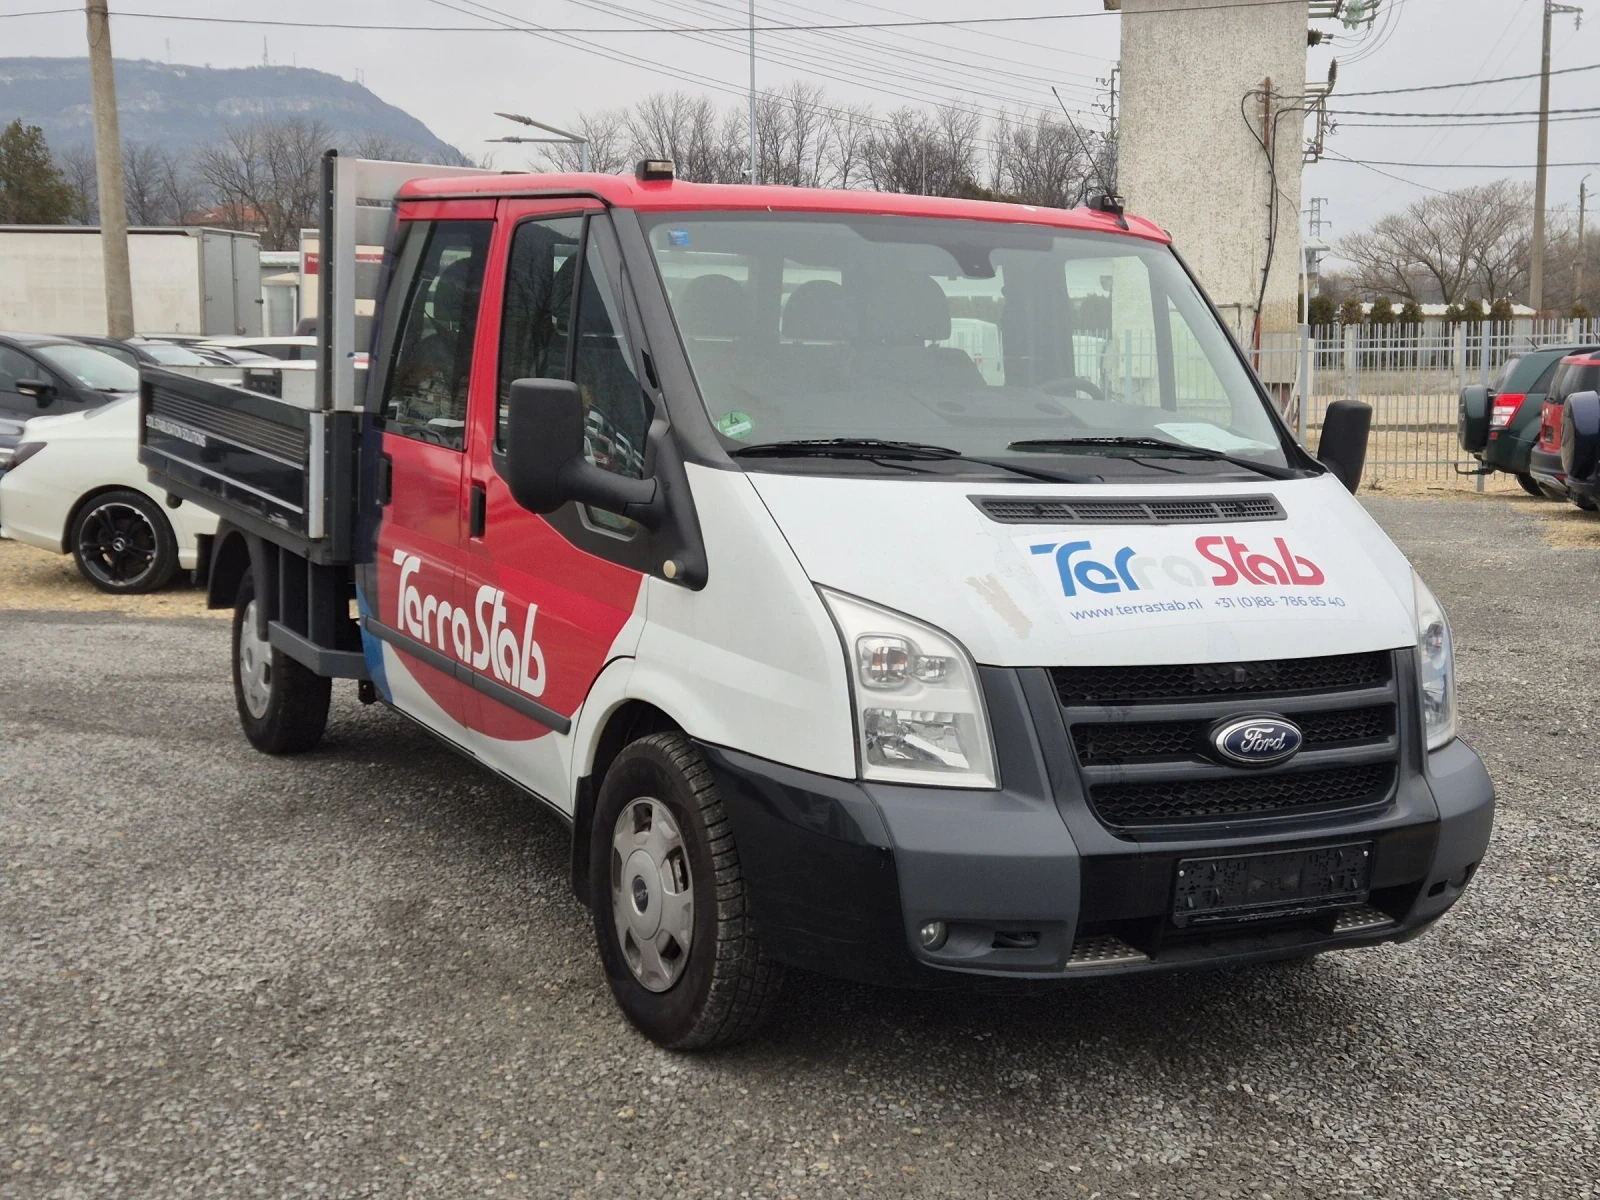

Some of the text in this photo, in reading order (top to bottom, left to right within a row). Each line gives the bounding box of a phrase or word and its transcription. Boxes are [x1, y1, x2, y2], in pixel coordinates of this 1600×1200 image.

[730, 413, 740, 424] 4
[1070, 599, 1203, 621] www.terrastab.nl
[1214, 597, 1236, 608] +31
[1280, 596, 1308, 607] 786
[1308, 596, 1327, 607] 85
[1328, 597, 1346, 607] 40
[1240, 727, 1287, 753] Ford
